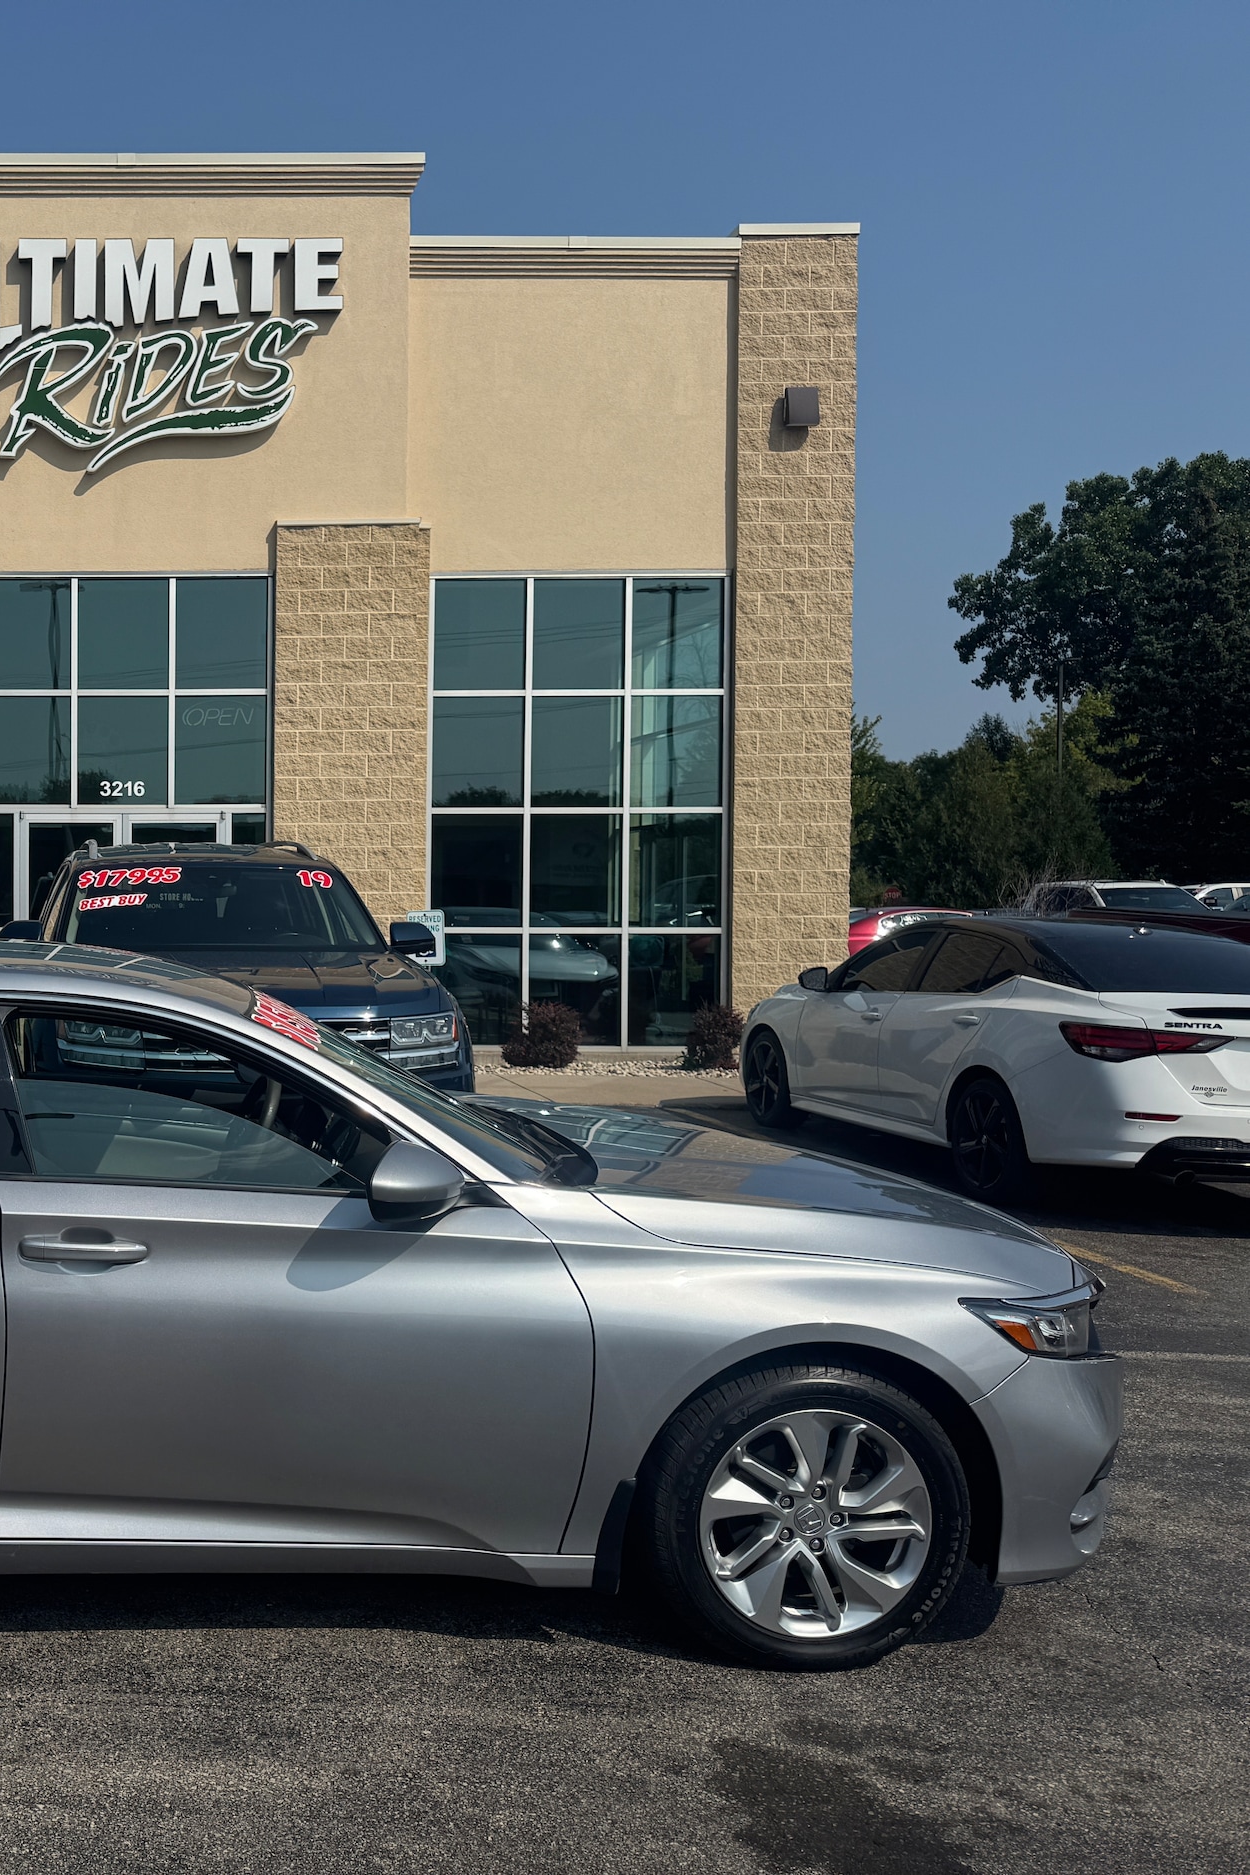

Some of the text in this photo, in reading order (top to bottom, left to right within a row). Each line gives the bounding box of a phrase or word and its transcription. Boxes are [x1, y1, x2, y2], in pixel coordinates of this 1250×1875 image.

[186, 707, 254, 726] OPEN
[100, 781, 145, 797] 3216
[77, 867, 182, 889] $17995
[296, 870, 333, 889] 19
[159, 893, 180, 901] STORE
[884, 891, 902, 900] STOP
[79, 894, 148, 911] BEST BUY
[408, 915, 441, 923] RESERVED
[1164, 1022, 1223, 1030] SENTRA
[1191, 1084, 1228, 1093] Janesville
